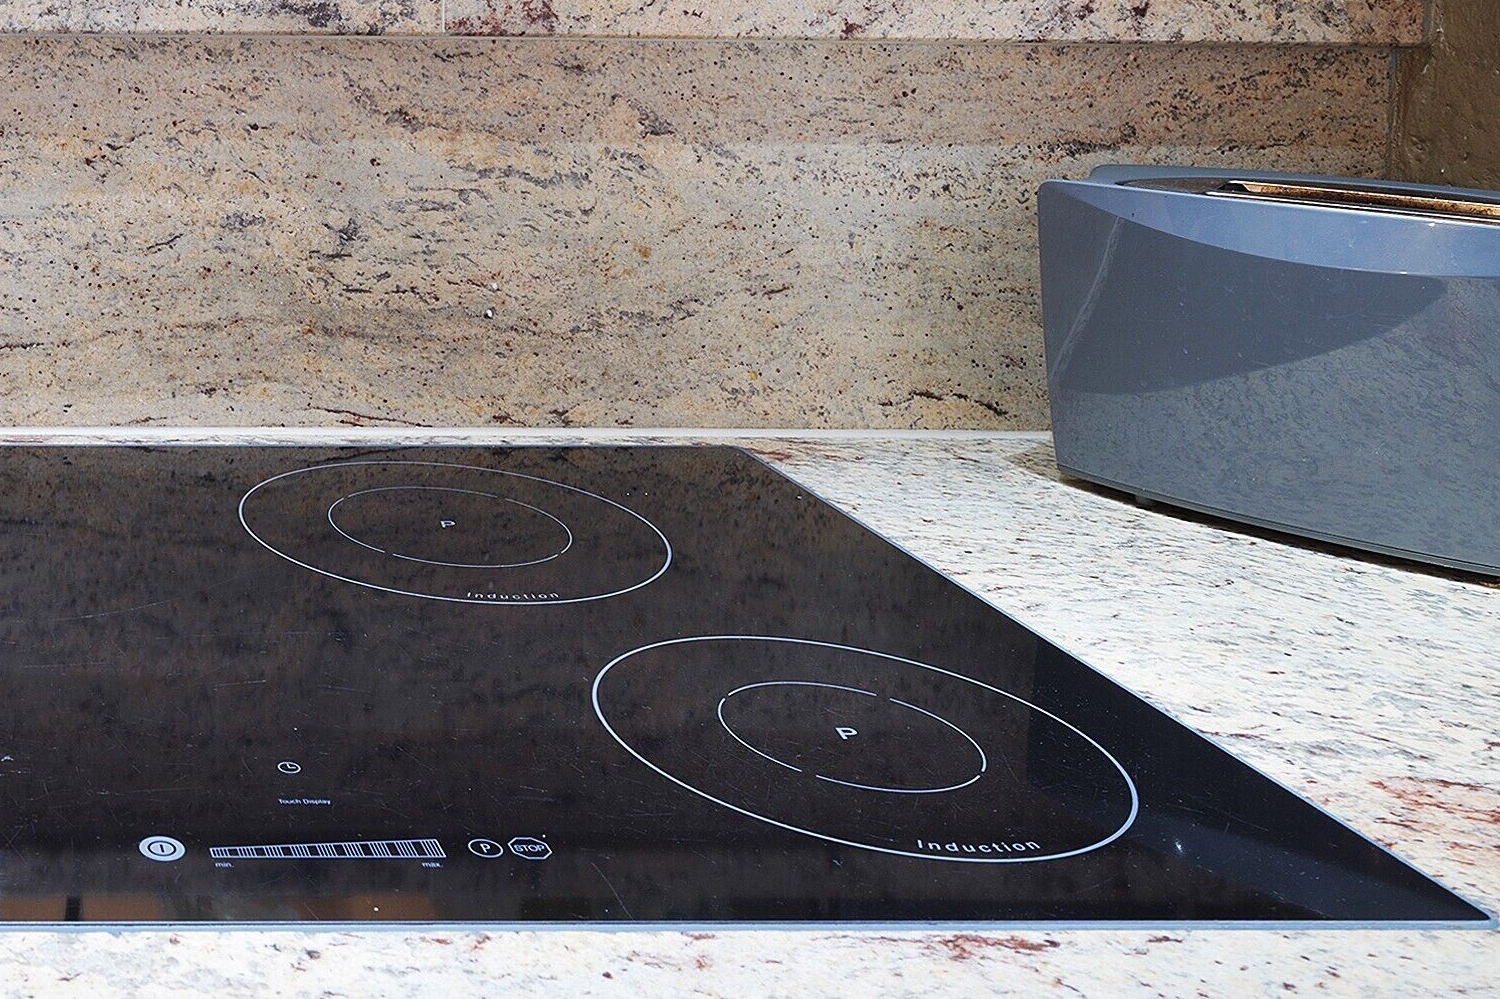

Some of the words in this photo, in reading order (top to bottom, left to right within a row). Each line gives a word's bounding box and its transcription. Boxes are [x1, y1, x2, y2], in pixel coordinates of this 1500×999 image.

[467, 591, 559, 599] Induction
[835, 726, 858, 740] P
[303, 798, 331, 806] Display
[480, 843, 491, 853] P
[514, 844, 545, 852] STOP
[916, 839, 1041, 853] Induction
